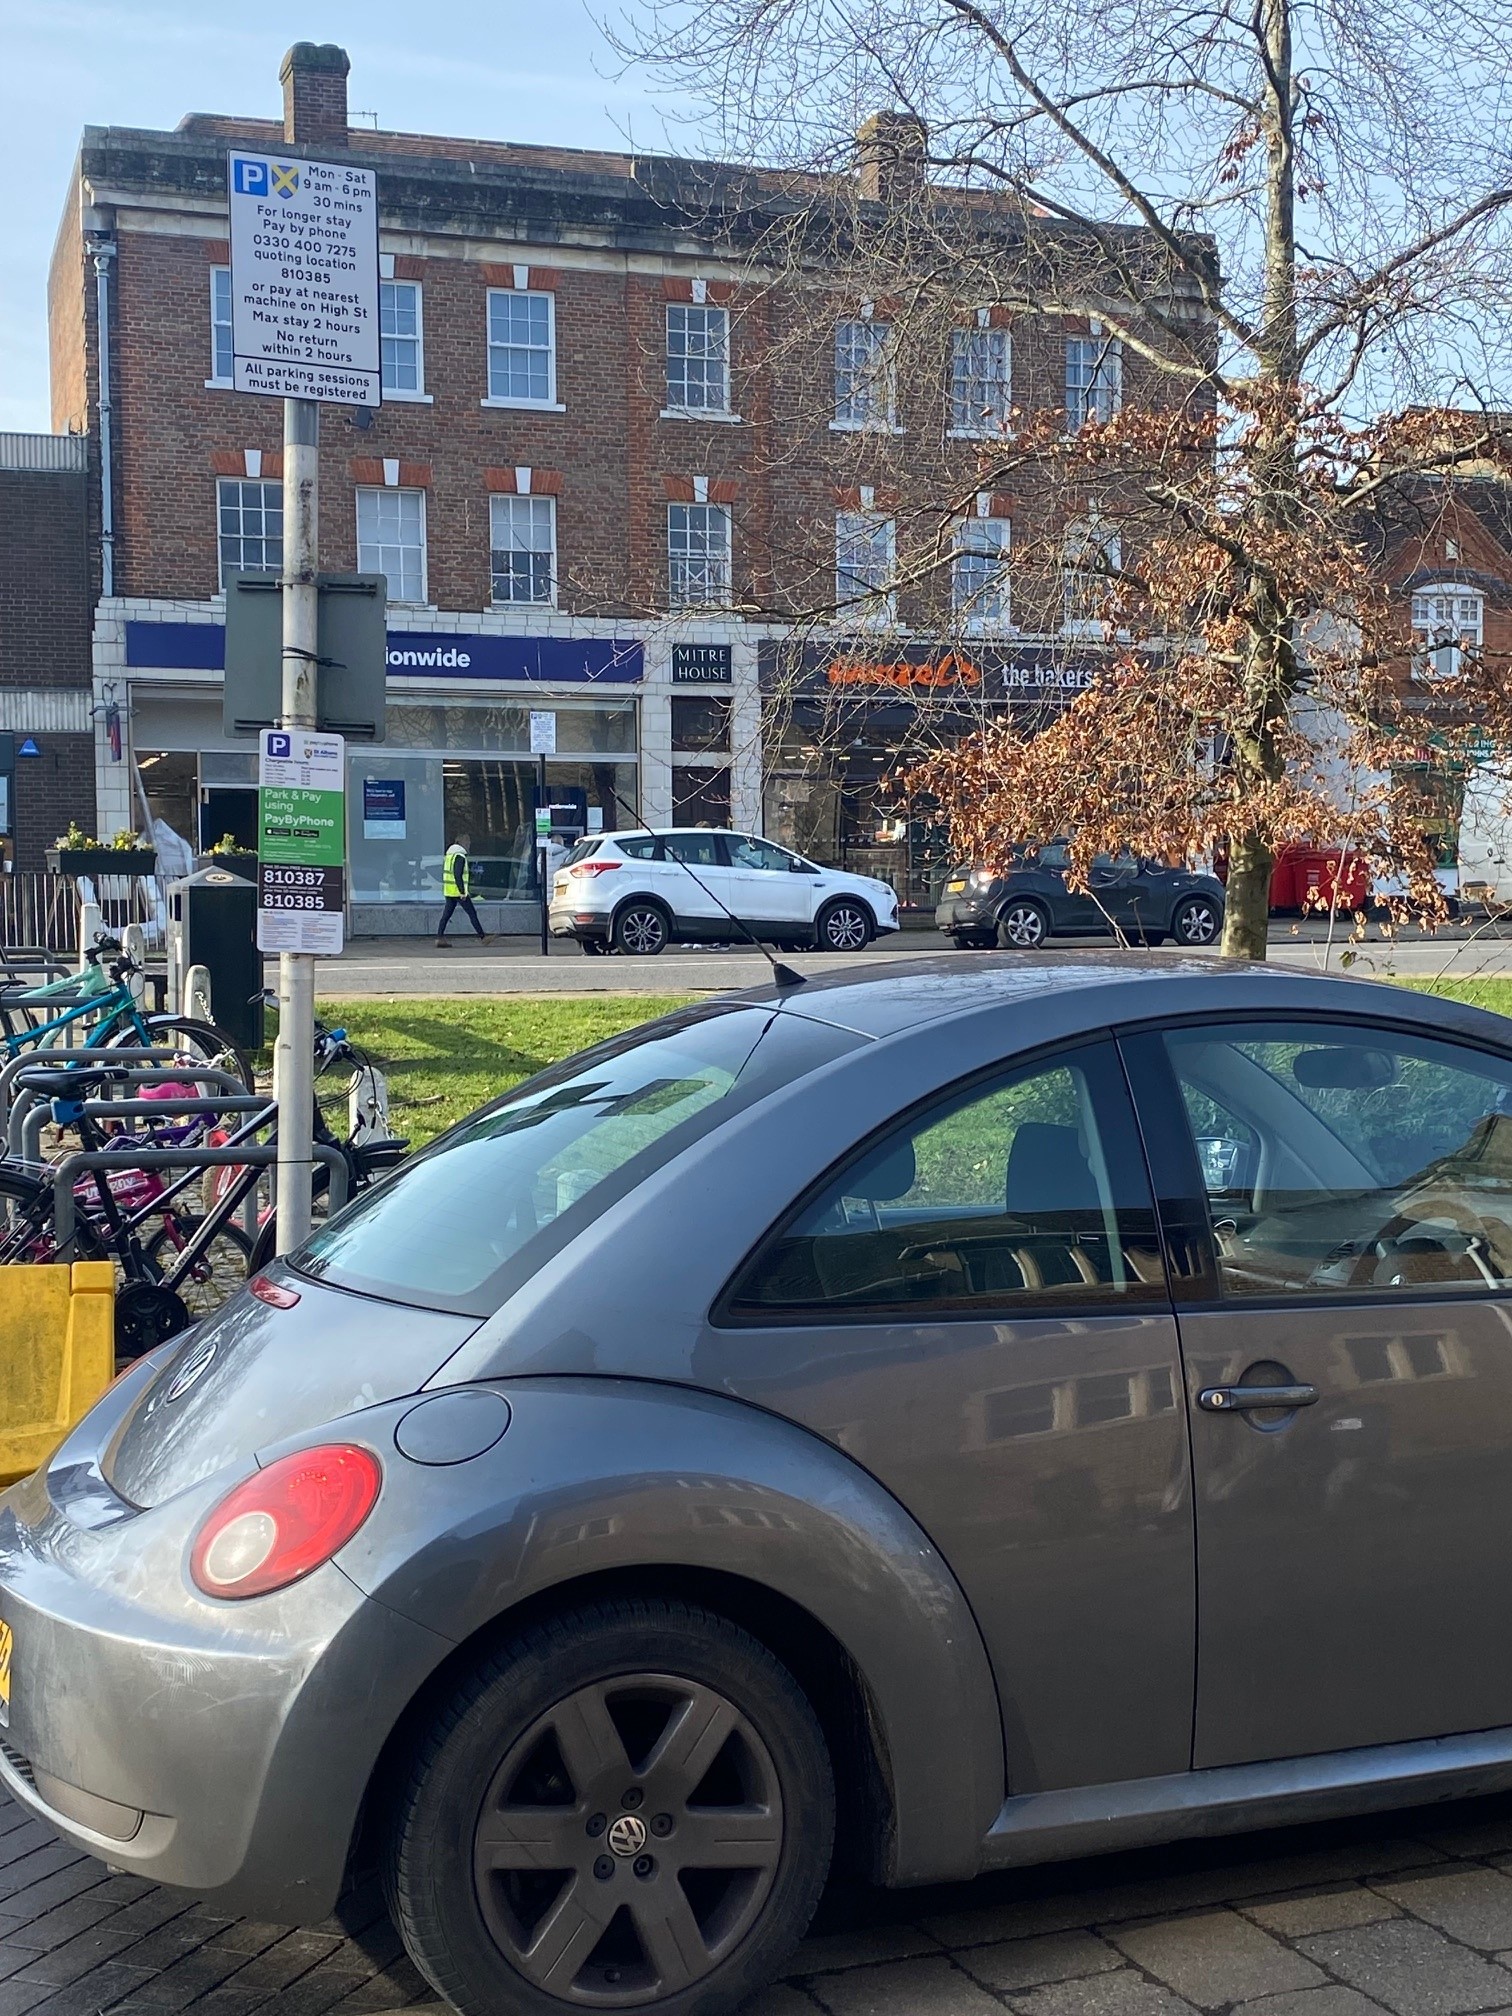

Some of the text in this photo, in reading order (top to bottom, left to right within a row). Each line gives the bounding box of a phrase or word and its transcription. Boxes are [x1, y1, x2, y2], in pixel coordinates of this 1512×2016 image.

[242, 164, 263, 191] P
[309, 166, 334, 179] Mon
[346, 172, 366, 184] Sat
[304, 179, 311, 189] 9
[315, 183, 331, 192] am
[342, 185, 350, 194] 6
[353, 188, 371, 198] pm
[314, 196, 362, 212] 30 mins
[258, 205, 351, 229] For longer stay
[263, 219, 346, 239] Pay by phone
[254, 235, 356, 257] 0330 400 7275
[254, 250, 356, 270] quoting location
[282, 268, 330, 283] 810385
[270, 285, 291, 297] pay
[296, 288, 308, 297] at
[313, 290, 359, 304] nearest
[244, 294, 367, 318] machine on High St
[253, 310, 360, 333] Max stay 2 hours
[277, 330, 337, 347] No return
[262, 343, 352, 362] within 2 hours
[245, 363, 369, 387] All parking sessions
[249, 379, 366, 399] must be registered
[679, 649, 727, 661] MITRE
[679, 667, 727, 679] HOUSE
[1002, 663, 1029, 686] the
[1035, 663, 1092, 687] bakers
[273, 737, 286, 753] P
[265, 789, 321, 803] Park & Pay
[265, 801, 293, 812] using
[265, 814, 334, 826] PayByPhone
[264, 870, 325, 885] 810387
[264, 894, 324, 909] 810385
